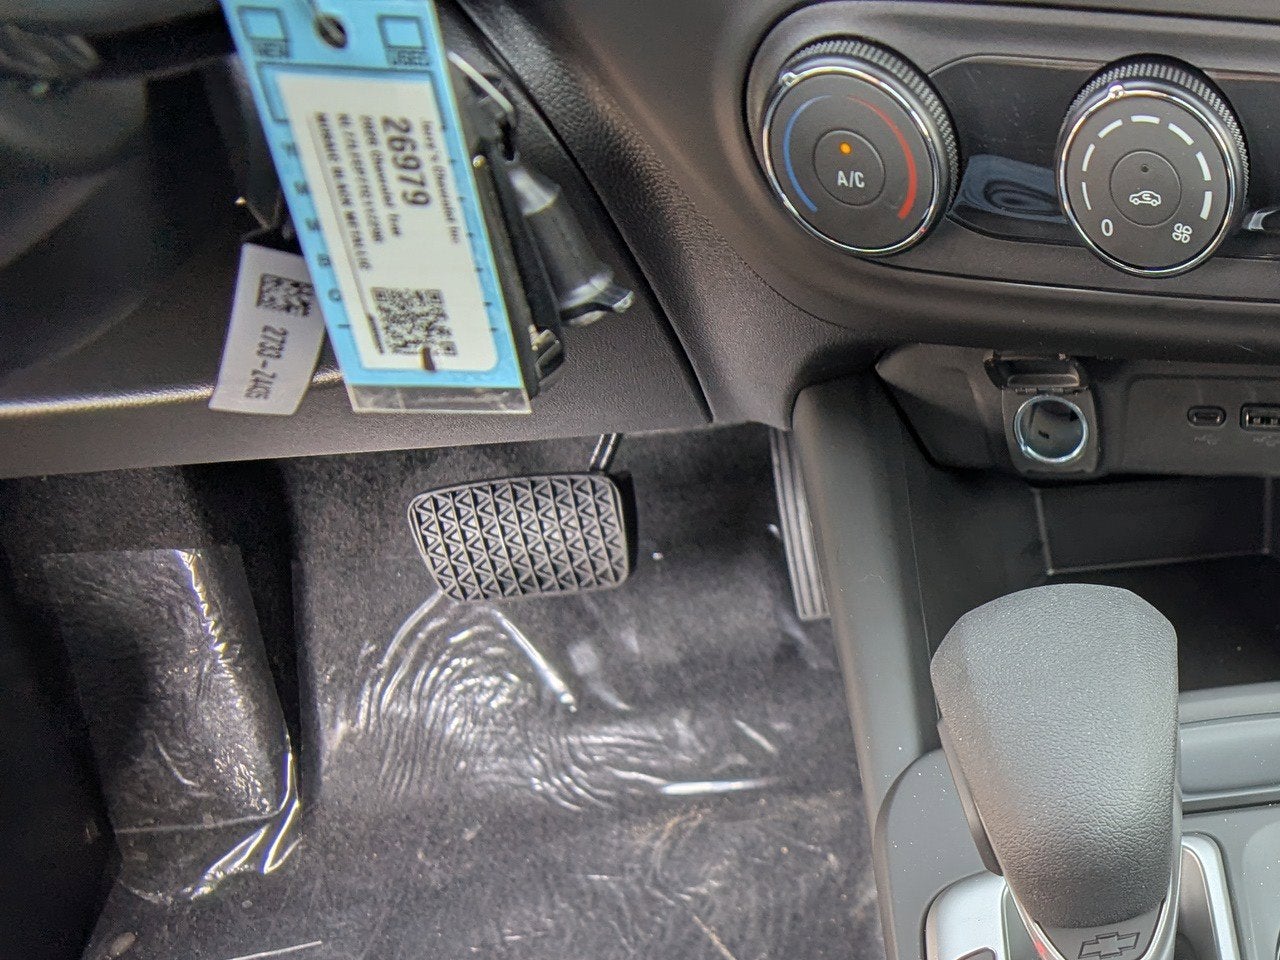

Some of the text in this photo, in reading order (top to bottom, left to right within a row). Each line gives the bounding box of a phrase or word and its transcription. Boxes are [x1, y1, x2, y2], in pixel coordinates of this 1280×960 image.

[381, 114, 432, 206] 26979
[837, 170, 866, 188] A/C
[1101, 218, 1114, 237] 0
